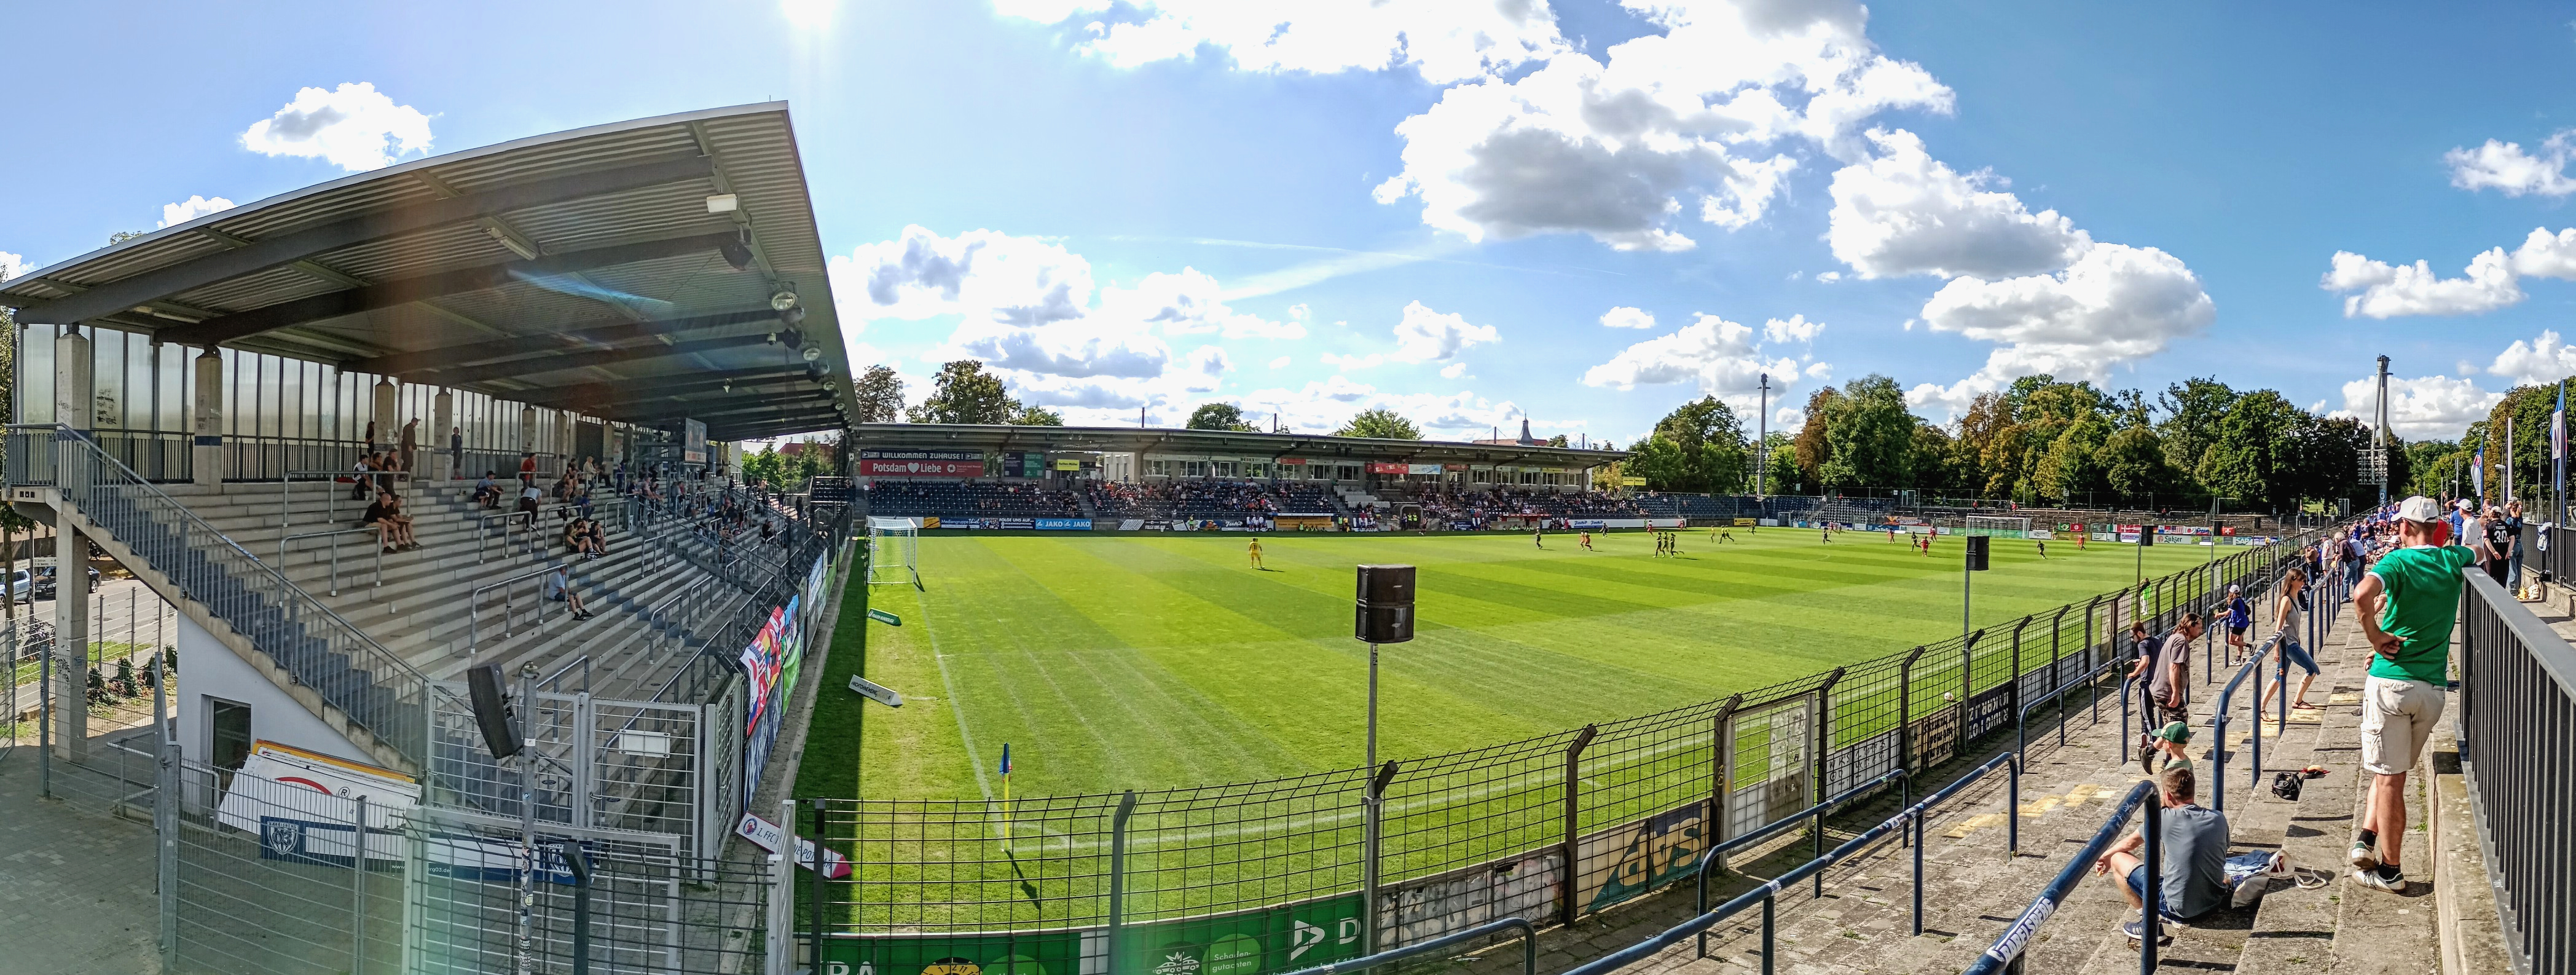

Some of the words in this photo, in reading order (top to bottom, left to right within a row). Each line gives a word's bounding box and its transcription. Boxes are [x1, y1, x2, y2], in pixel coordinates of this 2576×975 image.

[2554, 427, 2559, 454] N
[873, 462, 906, 473] Potsdam
[921, 463, 941, 473] Liebe
[2494, 530, 2507, 543] 30
[272, 831, 293, 847] 03
[756, 827, 763, 837] 1.
[763, 831, 773, 843] FFC
[1339, 917, 1362, 945] D
[1999, 898, 2054, 967] BABELSBERG
[1214, 950, 1251, 961] Schaden-
[1212, 960, 1252, 973] gutachten
